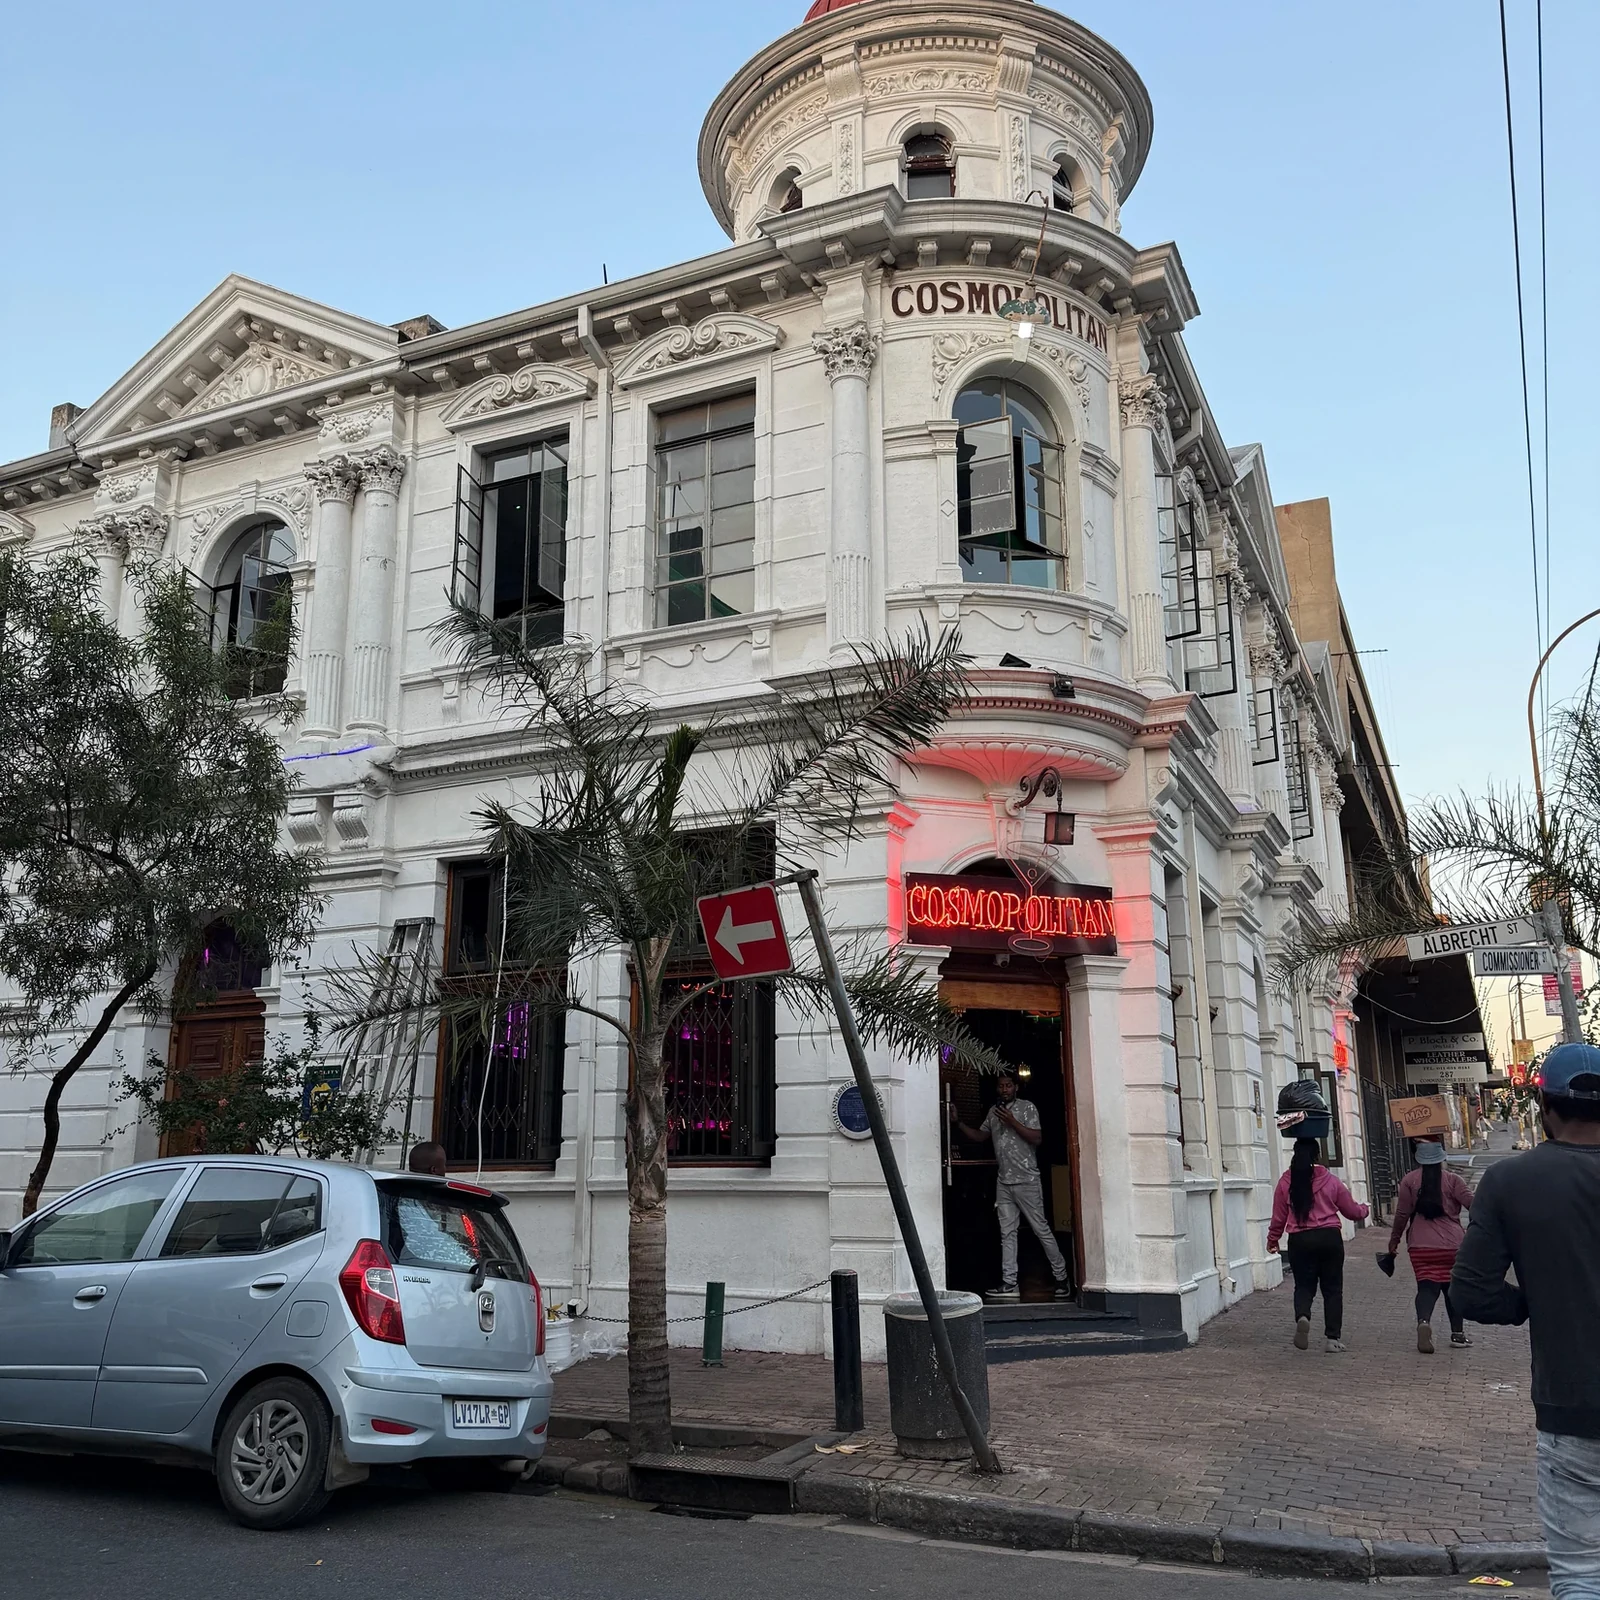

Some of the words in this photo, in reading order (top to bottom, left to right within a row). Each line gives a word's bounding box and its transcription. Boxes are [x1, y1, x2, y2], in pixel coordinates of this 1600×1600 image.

[891, 281, 1108, 354] COSMOOLITAN
[908, 883, 1116, 937] COSMOPOLITAN
[1423, 926, 1498, 956] ALBRECHT
[1507, 922, 1519, 935] ST
[1482, 951, 1540, 972] COMMISSIONER
[1420, 1036, 1447, 1044] Bloch
[1450, 1036, 1459, 1045] &
[1461, 1035, 1479, 1043] Co.
[1413, 1056, 1478, 1064] WHOLESALERS
[1405, 1107, 1431, 1122] MAQ
[455, 1403, 491, 1424] LV17LR
[497, 1404, 509, 1424] GP
